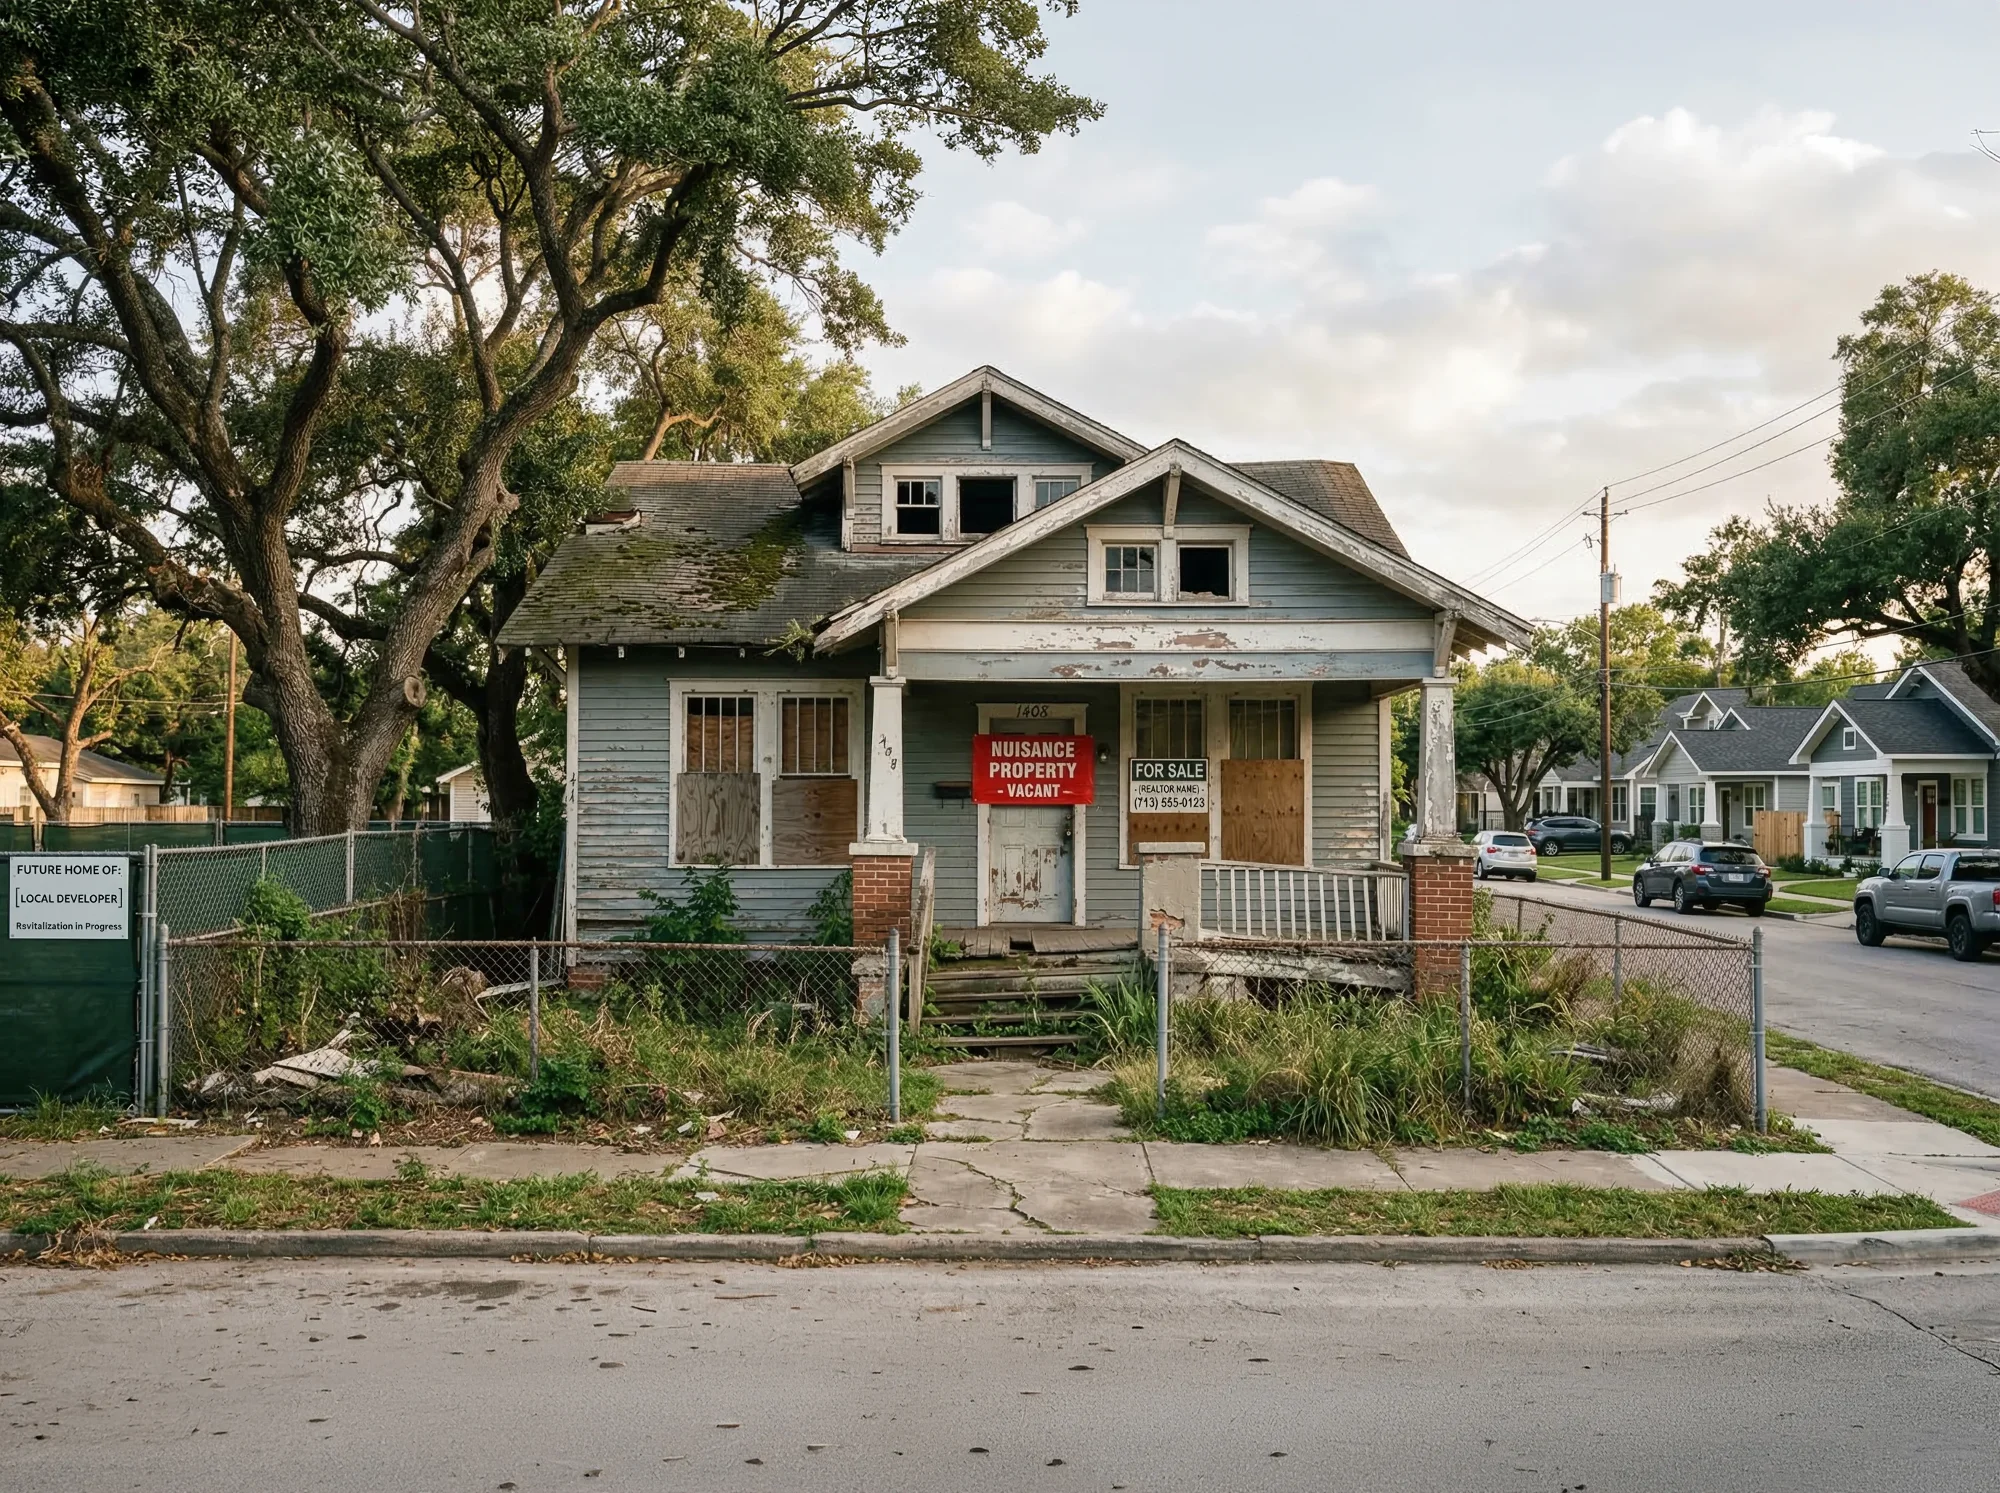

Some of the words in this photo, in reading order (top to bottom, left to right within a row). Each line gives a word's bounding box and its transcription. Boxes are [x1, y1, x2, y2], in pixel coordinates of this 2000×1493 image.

[1016, 704, 1049, 718] 1408
[991, 741, 1075, 758] NUISANCE
[989, 762, 1077, 778] PROPERTY
[1136, 763, 1164, 778] FOR
[1168, 763, 1204, 778] SALE
[1007, 783, 1060, 797] VACANT
[1134, 797, 1159, 810] (713)
[1161, 797, 1205, 808] 555-0123
[17, 865, 62, 875] FUTURE
[64, 865, 100, 875] HOME
[102, 865, 121, 875] OF:
[75, 922, 83, 930] in
[85, 922, 122, 932] Progress
